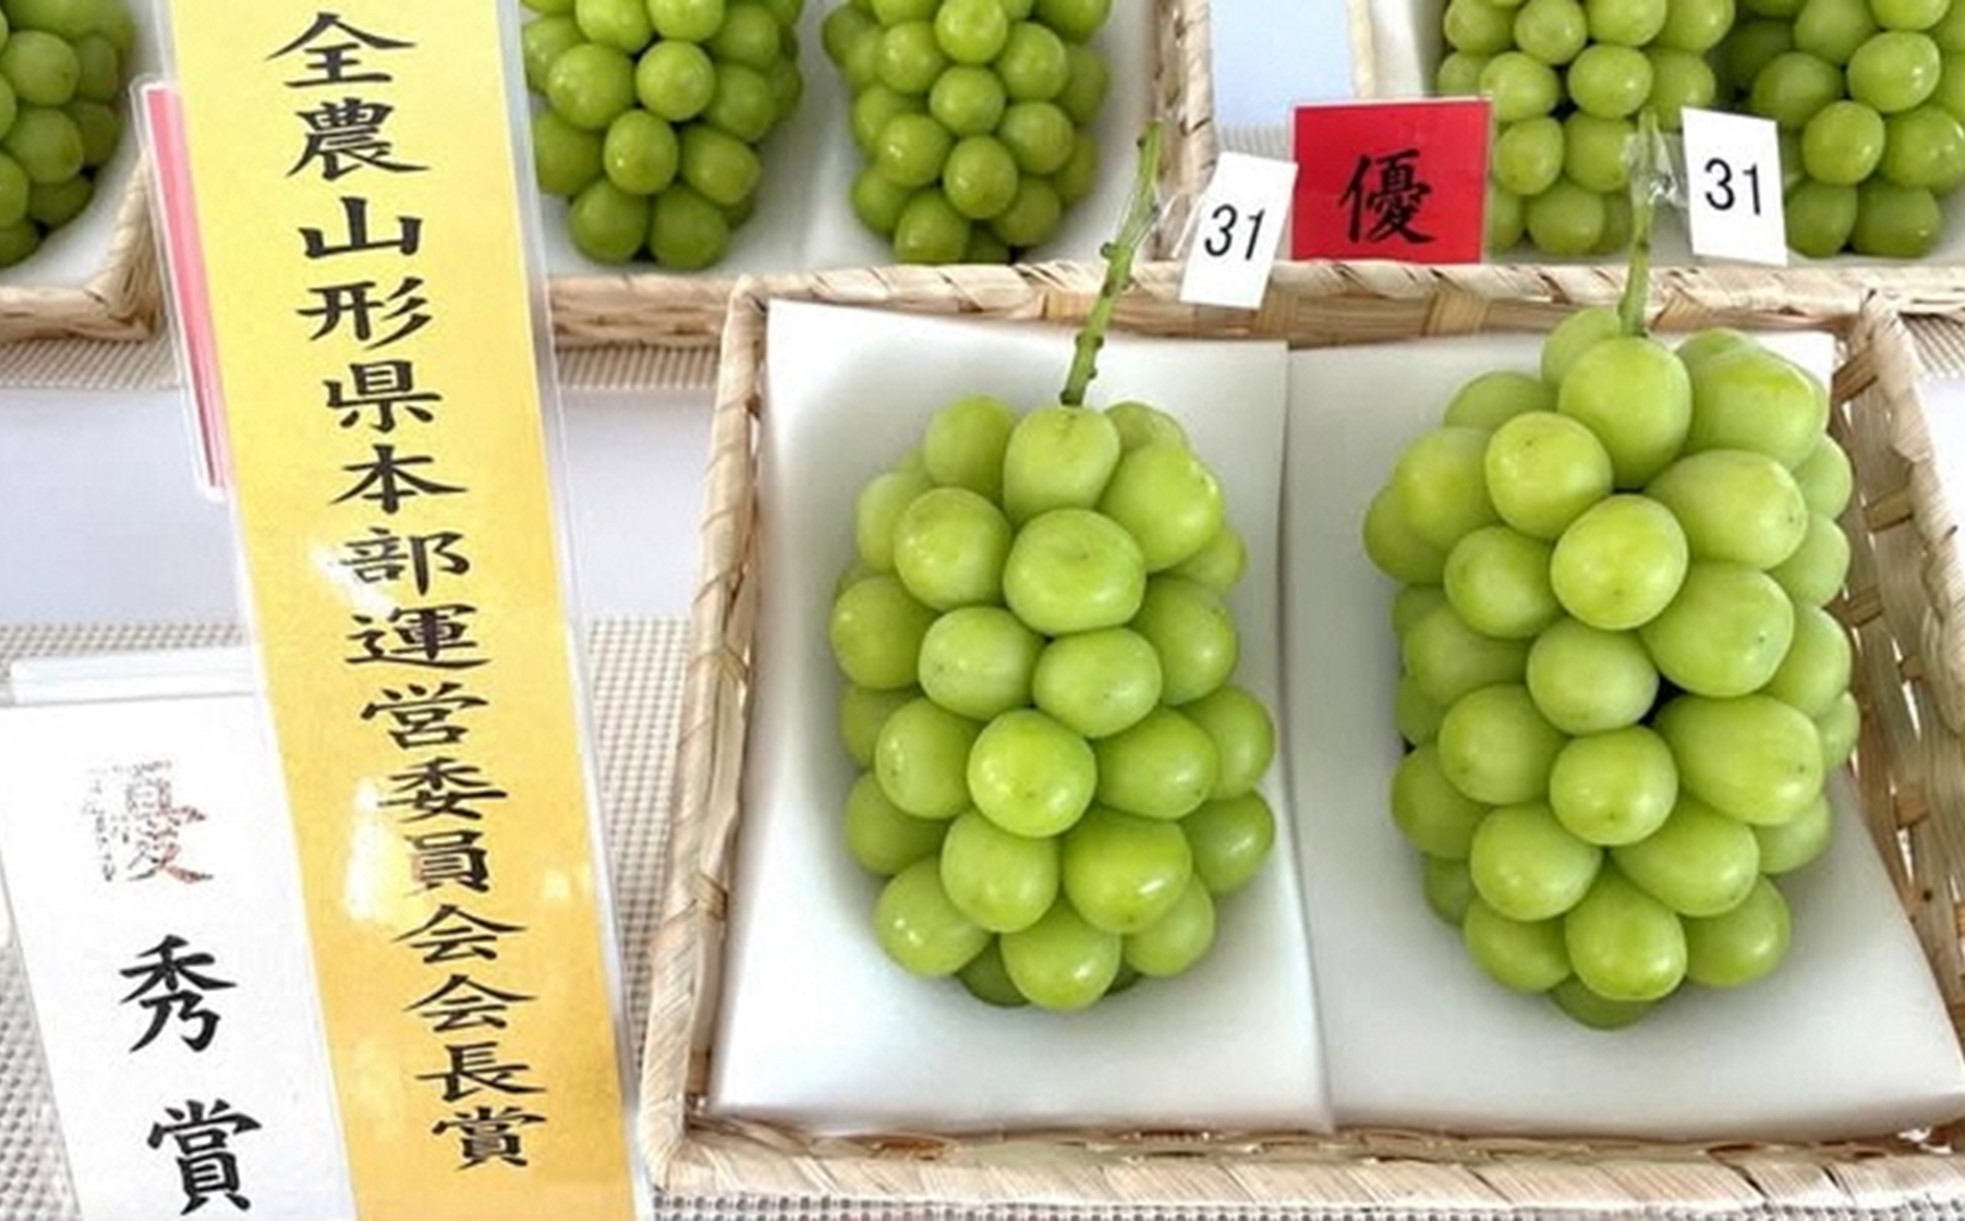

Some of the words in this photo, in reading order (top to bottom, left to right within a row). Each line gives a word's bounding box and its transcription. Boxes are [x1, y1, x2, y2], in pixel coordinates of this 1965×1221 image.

[1339, 148, 1436, 244] 優
[1704, 157, 1763, 216] 31
[1203, 203, 1266, 261] 31
[265, 12, 547, 1170] 全農山形県本部運営委員会会長賞
